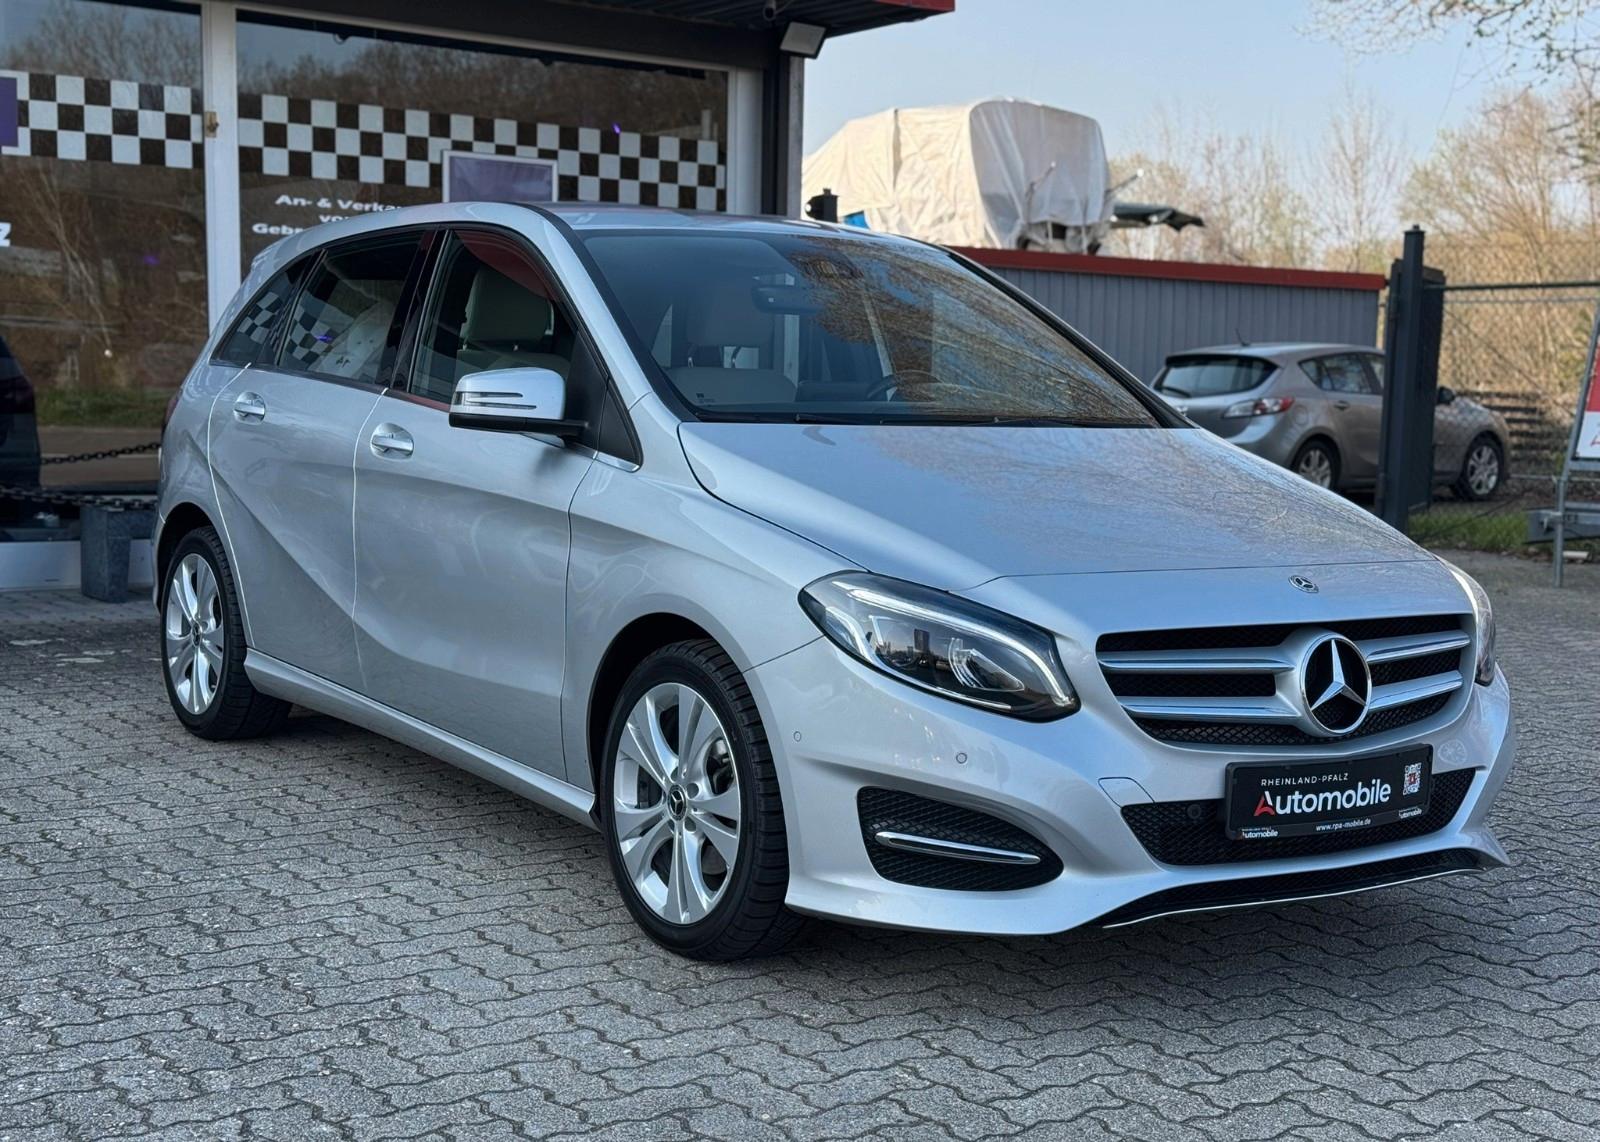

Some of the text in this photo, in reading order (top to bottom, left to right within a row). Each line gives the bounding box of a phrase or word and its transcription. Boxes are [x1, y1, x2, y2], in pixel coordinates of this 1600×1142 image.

[275, 194, 402, 212] An- & Verka
[1260, 772, 1349, 787] RHEINLAND-PFALZ
[1253, 778, 1392, 817] Automobile
[1315, 818, 1371, 832] www.rpa-mobile.de
